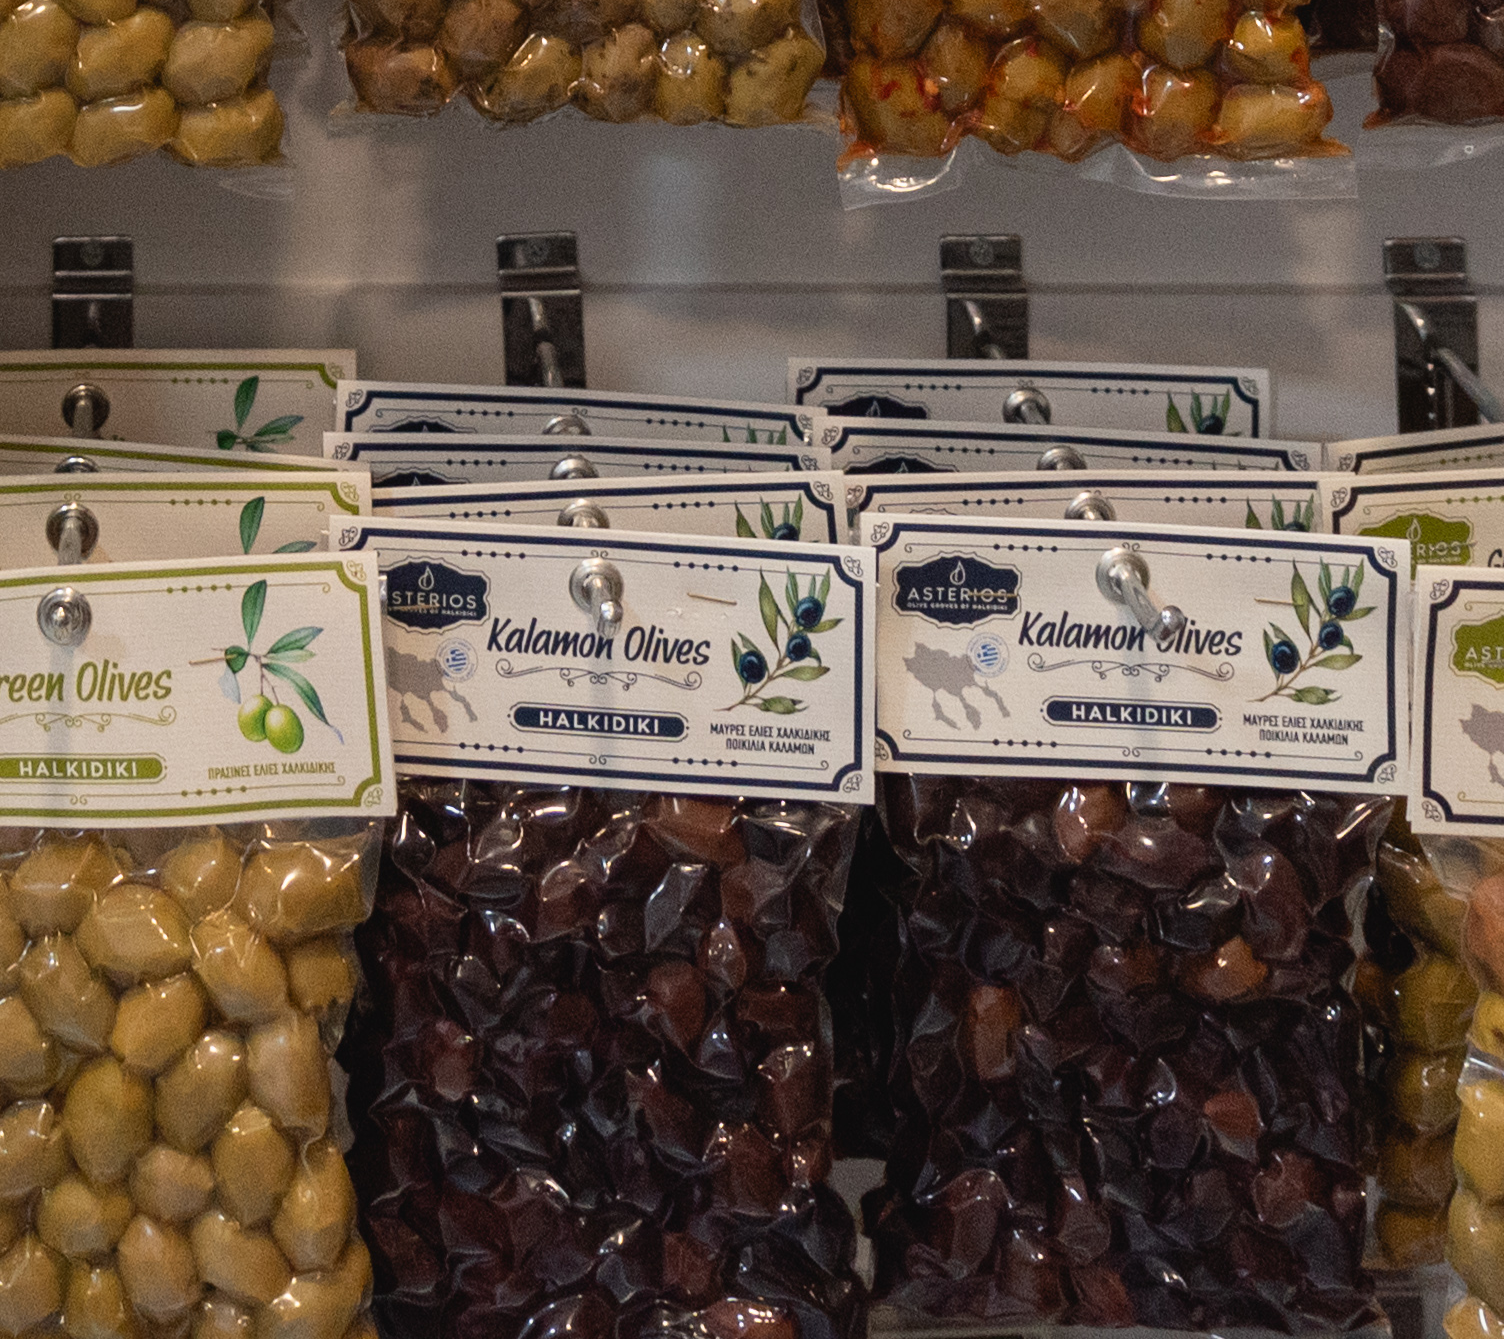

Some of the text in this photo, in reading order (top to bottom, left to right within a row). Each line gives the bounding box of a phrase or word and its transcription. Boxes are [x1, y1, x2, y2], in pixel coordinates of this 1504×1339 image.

[391, 590, 477, 609] STERIOS
[907, 587, 1008, 603] ASTERIOS
[1018, 610, 1144, 652] Kalamon
[487, 617, 614, 660] Kalamon
[624, 625, 710, 665] Olives
[77, 659, 171, 702] Olives
[538, 711, 661, 735] HALKIDIKI
[1072, 704, 1191, 725] HALKIDIKI
[1243, 714, 1364, 732] ΜΑΥΡΕΣ ΕΛΙΕΣ ΧΑΛΚΙΔΙΚΗΣ
[710, 723, 830, 742] ΜΑΥΡΕΣ ΕΛΙΕΣ ΧΑΛΚΙΔΙΚΗΣ
[1259, 729, 1348, 745] ΠΟΙΚΙΛΙΑ ΚΑΛΑΜΩΝ
[726, 738, 814, 755] ΠΟΙΚΙΛΙΑ ΚΑΛΑΜΩΝ
[19, 761, 136, 777] HALKIDIKI
[208, 762, 336, 779] ΠΡΑΣΙΝΕΣ ΕΛΙΕΣ ΧΑΛΚΙΔΙΚΗΣ
